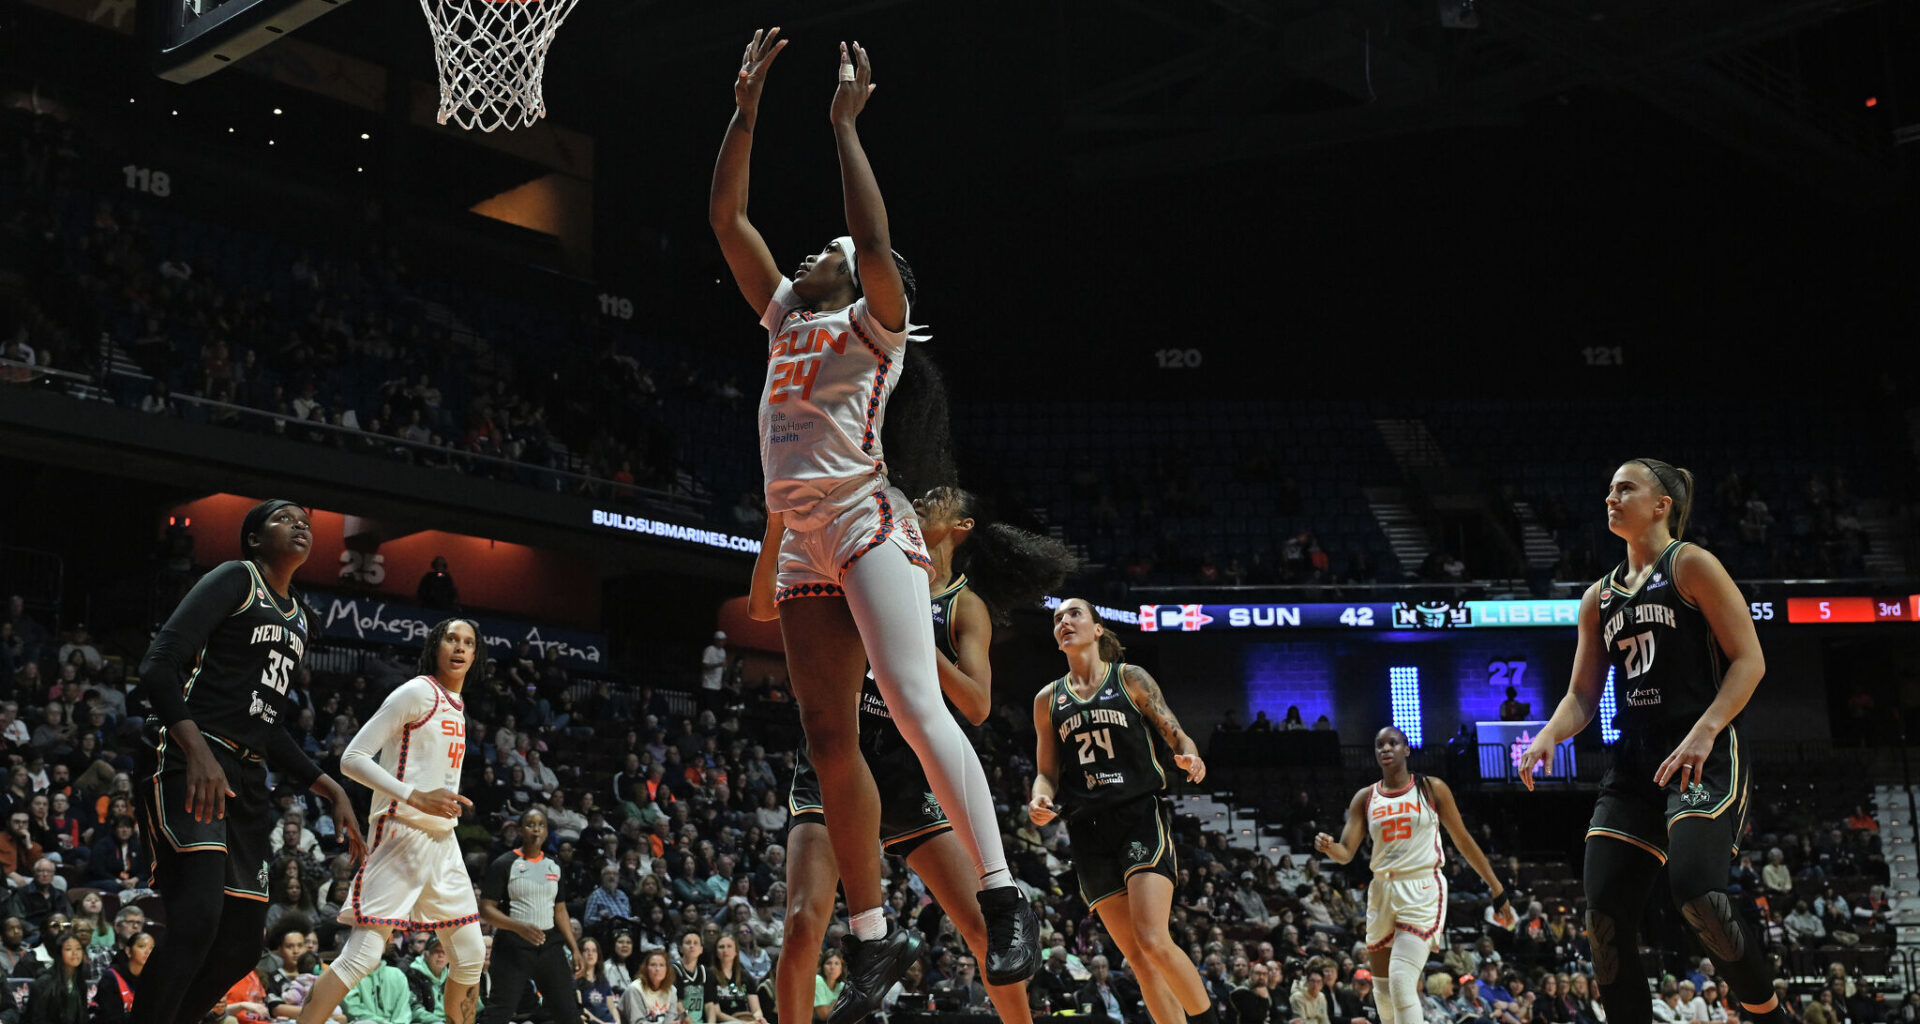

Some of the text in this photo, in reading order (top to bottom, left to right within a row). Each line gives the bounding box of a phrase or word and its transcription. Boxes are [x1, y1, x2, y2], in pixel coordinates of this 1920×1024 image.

[122, 164, 171, 197] 118
[598, 293, 634, 320] 119
[770, 328, 849, 360] SUN
[1580, 346, 1624, 367] 121
[1154, 348, 1202, 369] 120
[769, 360, 821, 405] 24
[770, 411, 786, 421] ale
[770, 432, 799, 445] Health
[592, 509, 762, 554] BUILDSUBMARINES.COM
[339, 550, 385, 584] 25
[1229, 607, 1300, 627] SUN
[1339, 607, 1374, 627] 42
[1481, 604, 1581, 623] LIBER
[1750, 602, 1774, 621] 55
[1819, 601, 1831, 620] 5
[1878, 602, 1901, 617] 3rd
[250, 624, 282, 645] NEW
[326, 598, 434, 642] Mohega
[525, 626, 600, 663] Arena
[1603, 603, 1677, 653] NEW YORK
[1616, 630, 1656, 680] 20
[261, 649, 295, 696] 35
[1488, 661, 1527, 685] 27
[1627, 695, 1662, 708] Mutual
[441, 720, 466, 737] SU
[1059, 708, 1128, 743] NEW YORK
[1074, 727, 1115, 765] 24
[1372, 802, 1421, 820] SUN
[1381, 817, 1411, 842] 25
